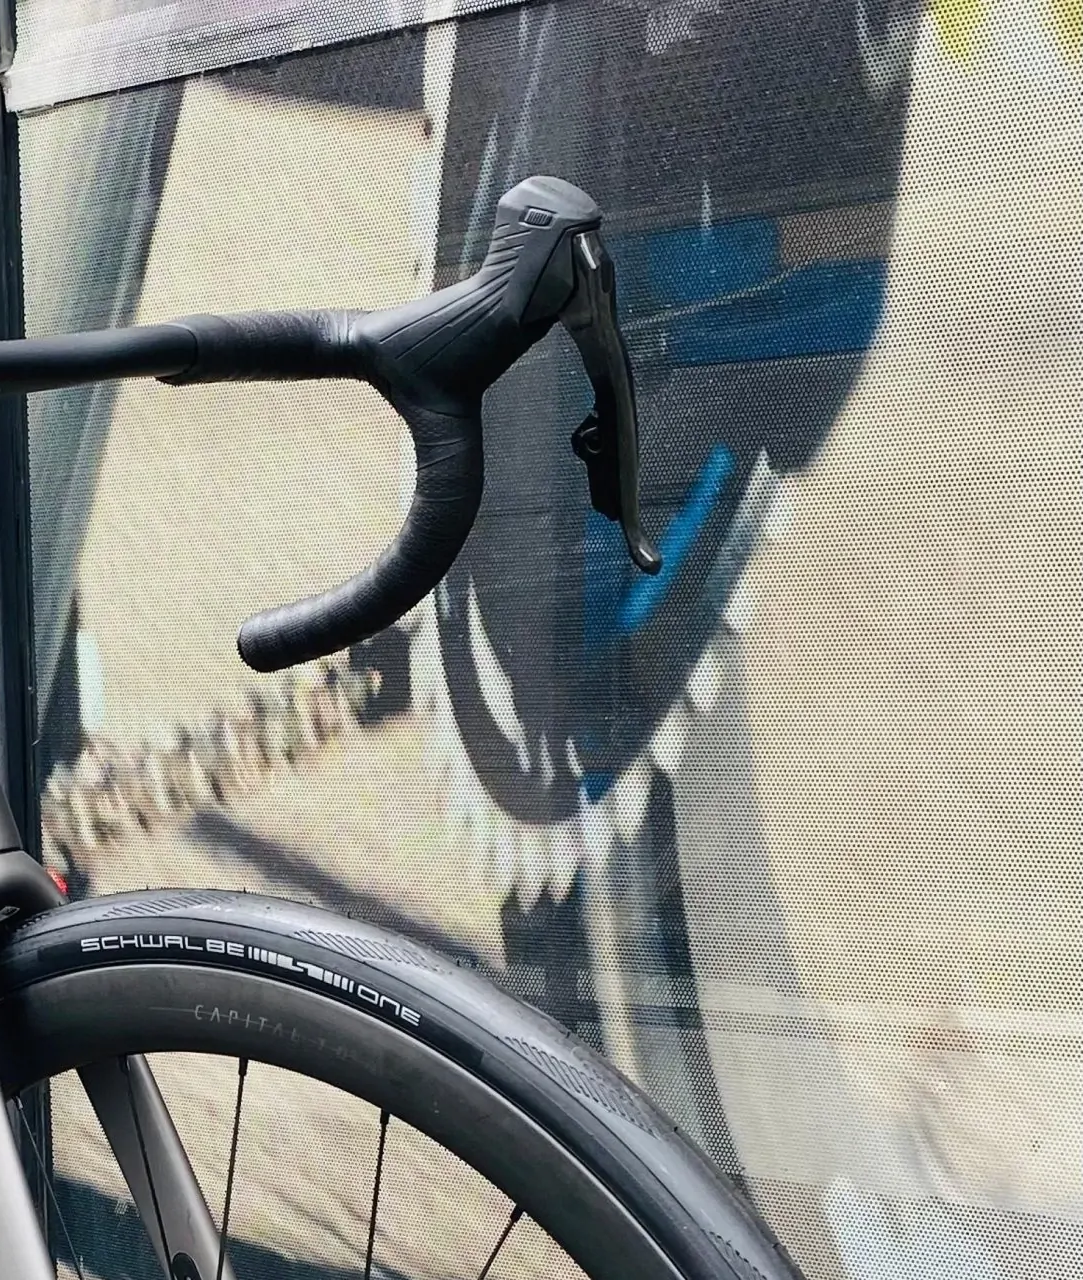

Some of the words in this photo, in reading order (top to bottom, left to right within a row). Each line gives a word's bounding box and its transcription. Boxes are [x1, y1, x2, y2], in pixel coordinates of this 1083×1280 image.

[81, 935, 245, 957] SCHWALBE
[357, 984, 422, 1027] ONE
[195, 1004, 300, 1042] CAPITAL
